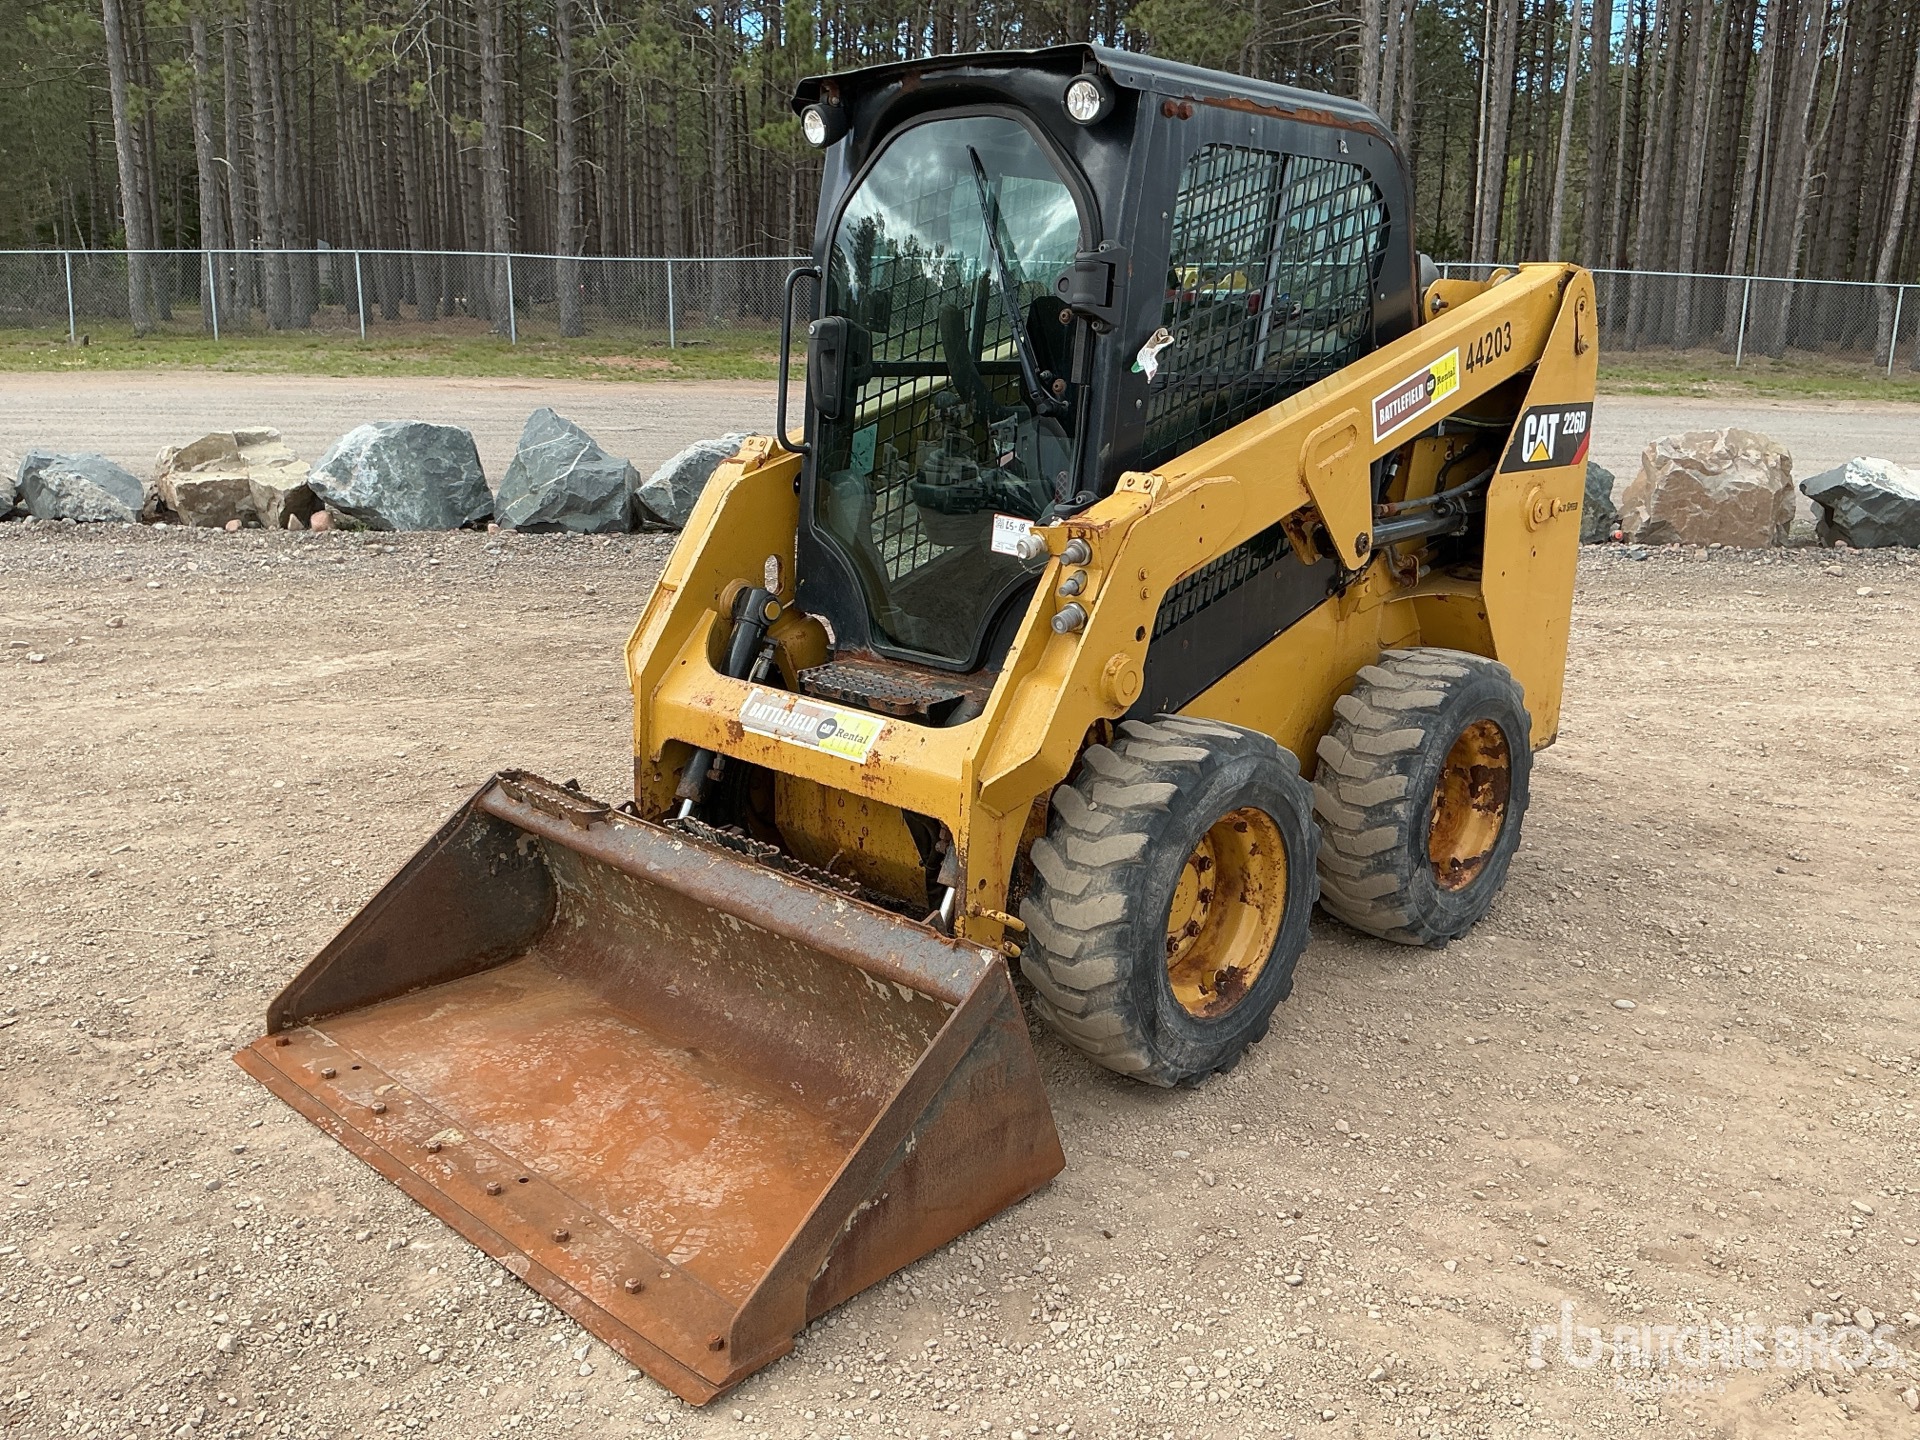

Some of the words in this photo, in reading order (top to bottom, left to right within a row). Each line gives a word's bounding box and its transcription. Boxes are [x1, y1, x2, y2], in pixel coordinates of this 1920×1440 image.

[1465, 321, 1512, 374] 44203
[1379, 383, 1424, 426] BATTLEFIELD
[1436, 366, 1456, 386] Rental
[1521, 411, 1560, 463] CAT
[1562, 410, 1586, 435] 226D
[747, 702, 819, 733] BATTLEFIELD
[835, 728, 870, 745] Rental
